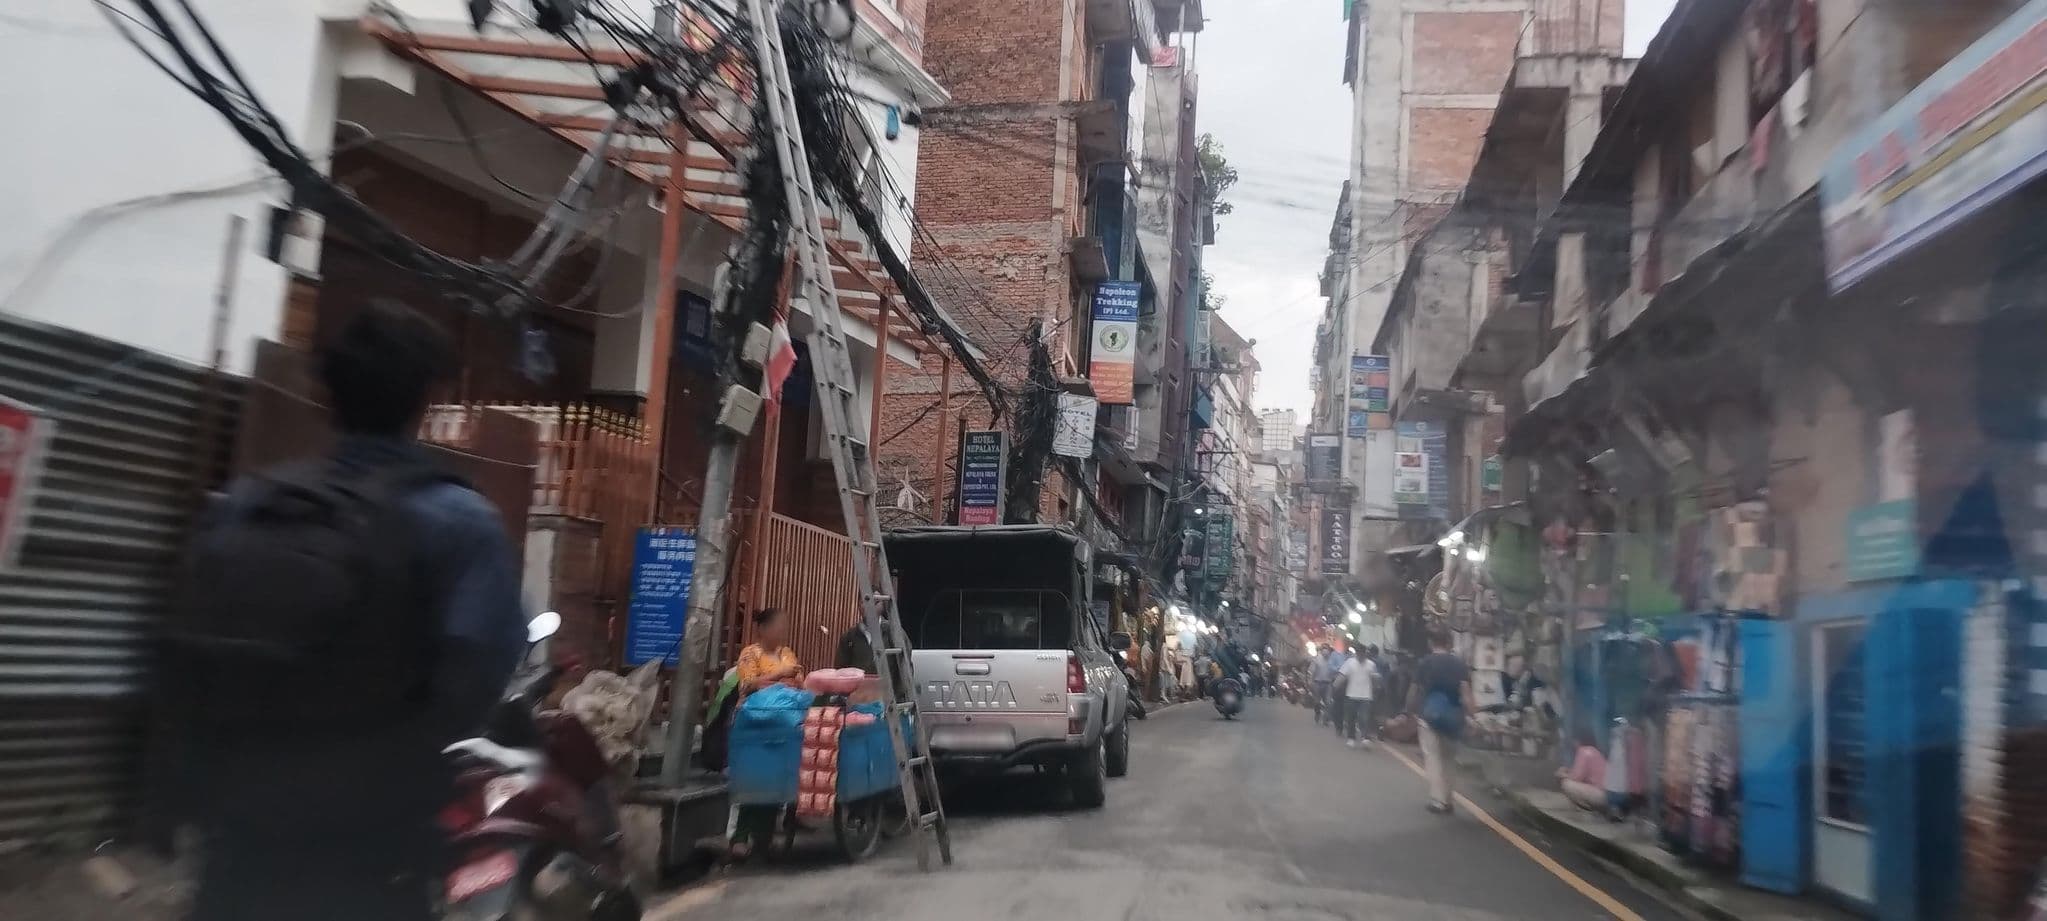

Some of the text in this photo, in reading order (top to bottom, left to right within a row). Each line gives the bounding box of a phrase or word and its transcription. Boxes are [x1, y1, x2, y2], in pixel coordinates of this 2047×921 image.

[1096, 297, 1138, 308] Trekking
[972, 435, 995, 444] HOTEL
[966, 444, 1000, 453] NEPALAYA
[1331, 513, 1344, 559] TATTOO
[928, 680, 1017, 708] TATA
